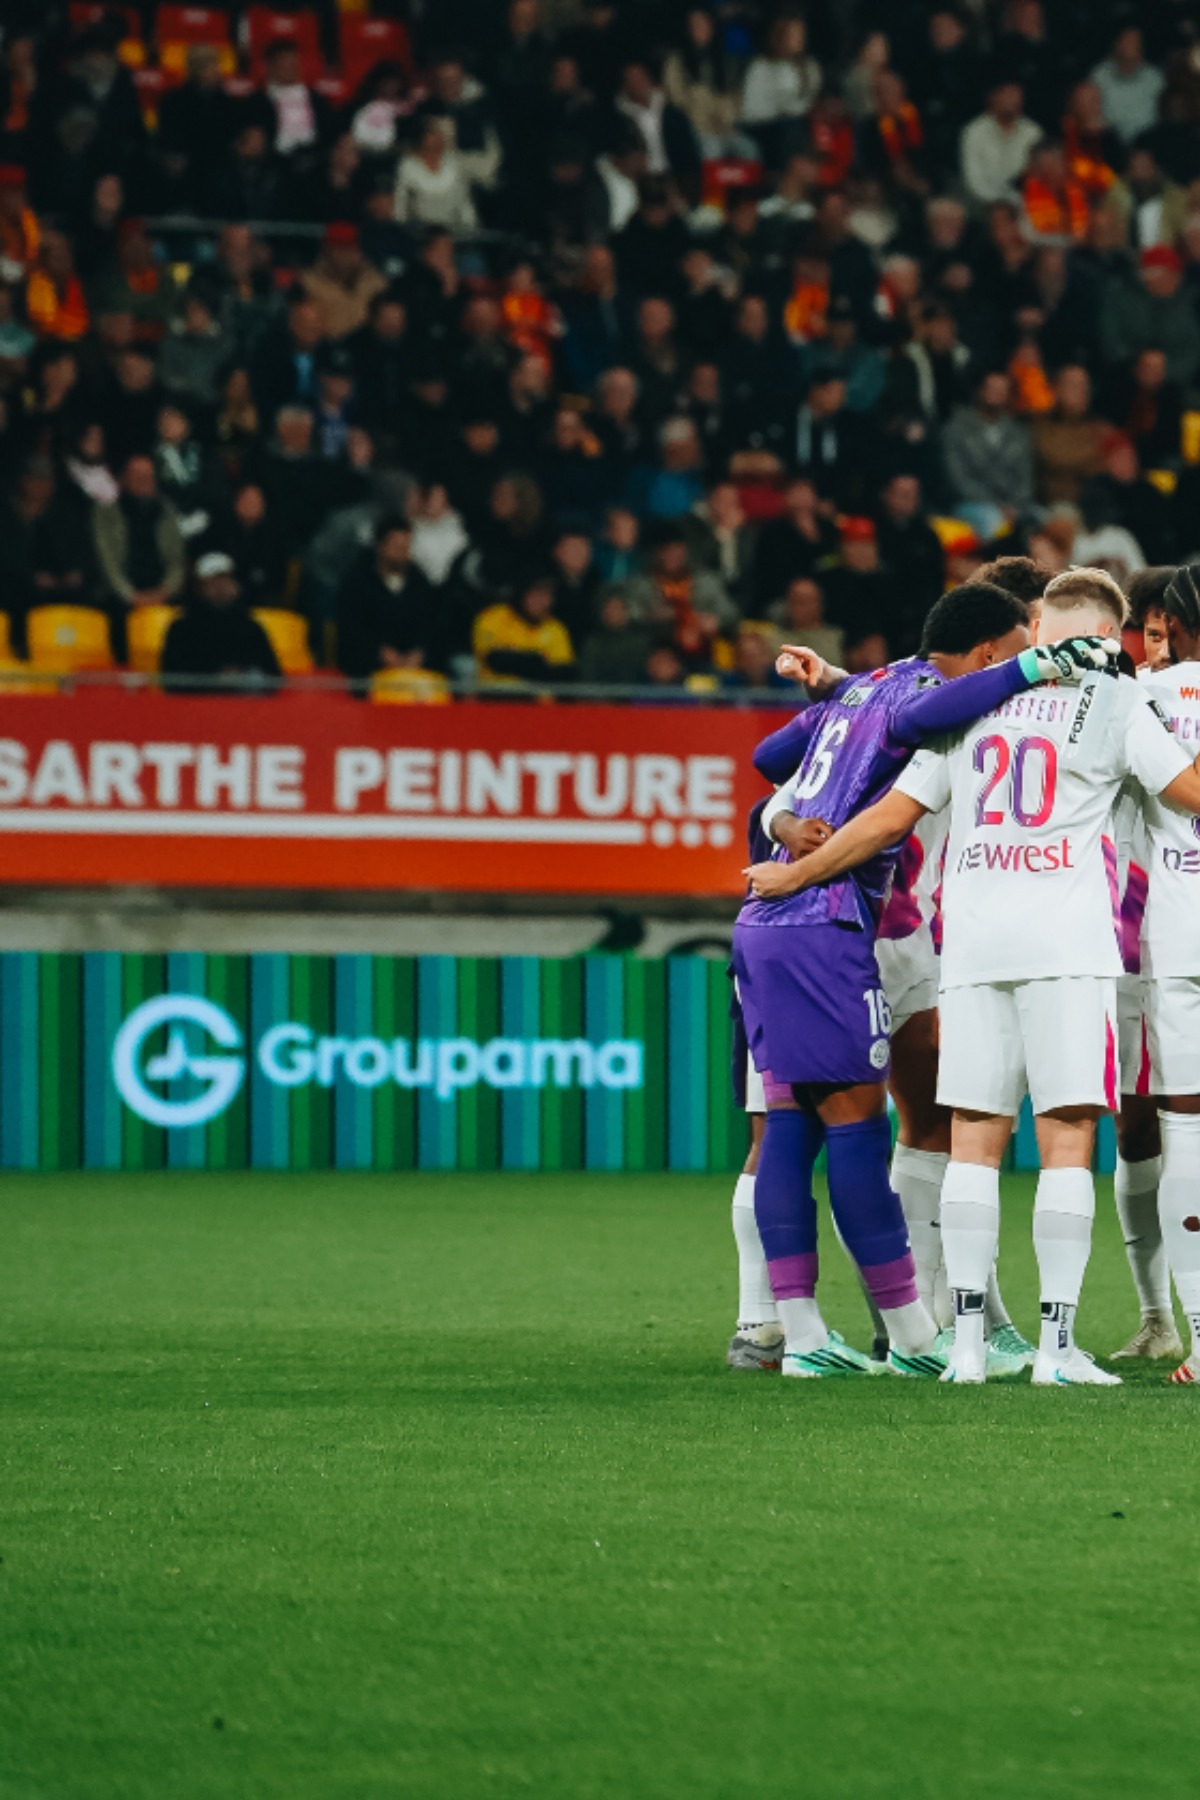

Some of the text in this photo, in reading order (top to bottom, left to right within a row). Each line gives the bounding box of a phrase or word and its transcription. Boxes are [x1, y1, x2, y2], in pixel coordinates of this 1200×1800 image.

[1068, 684, 1096, 744] FORZA
[0, 737, 735, 818] SARTHE PEINTURE
[973, 734, 1057, 828] 20
[863, 988, 892, 1036] 16
[258, 1022, 645, 1099] Groupama
